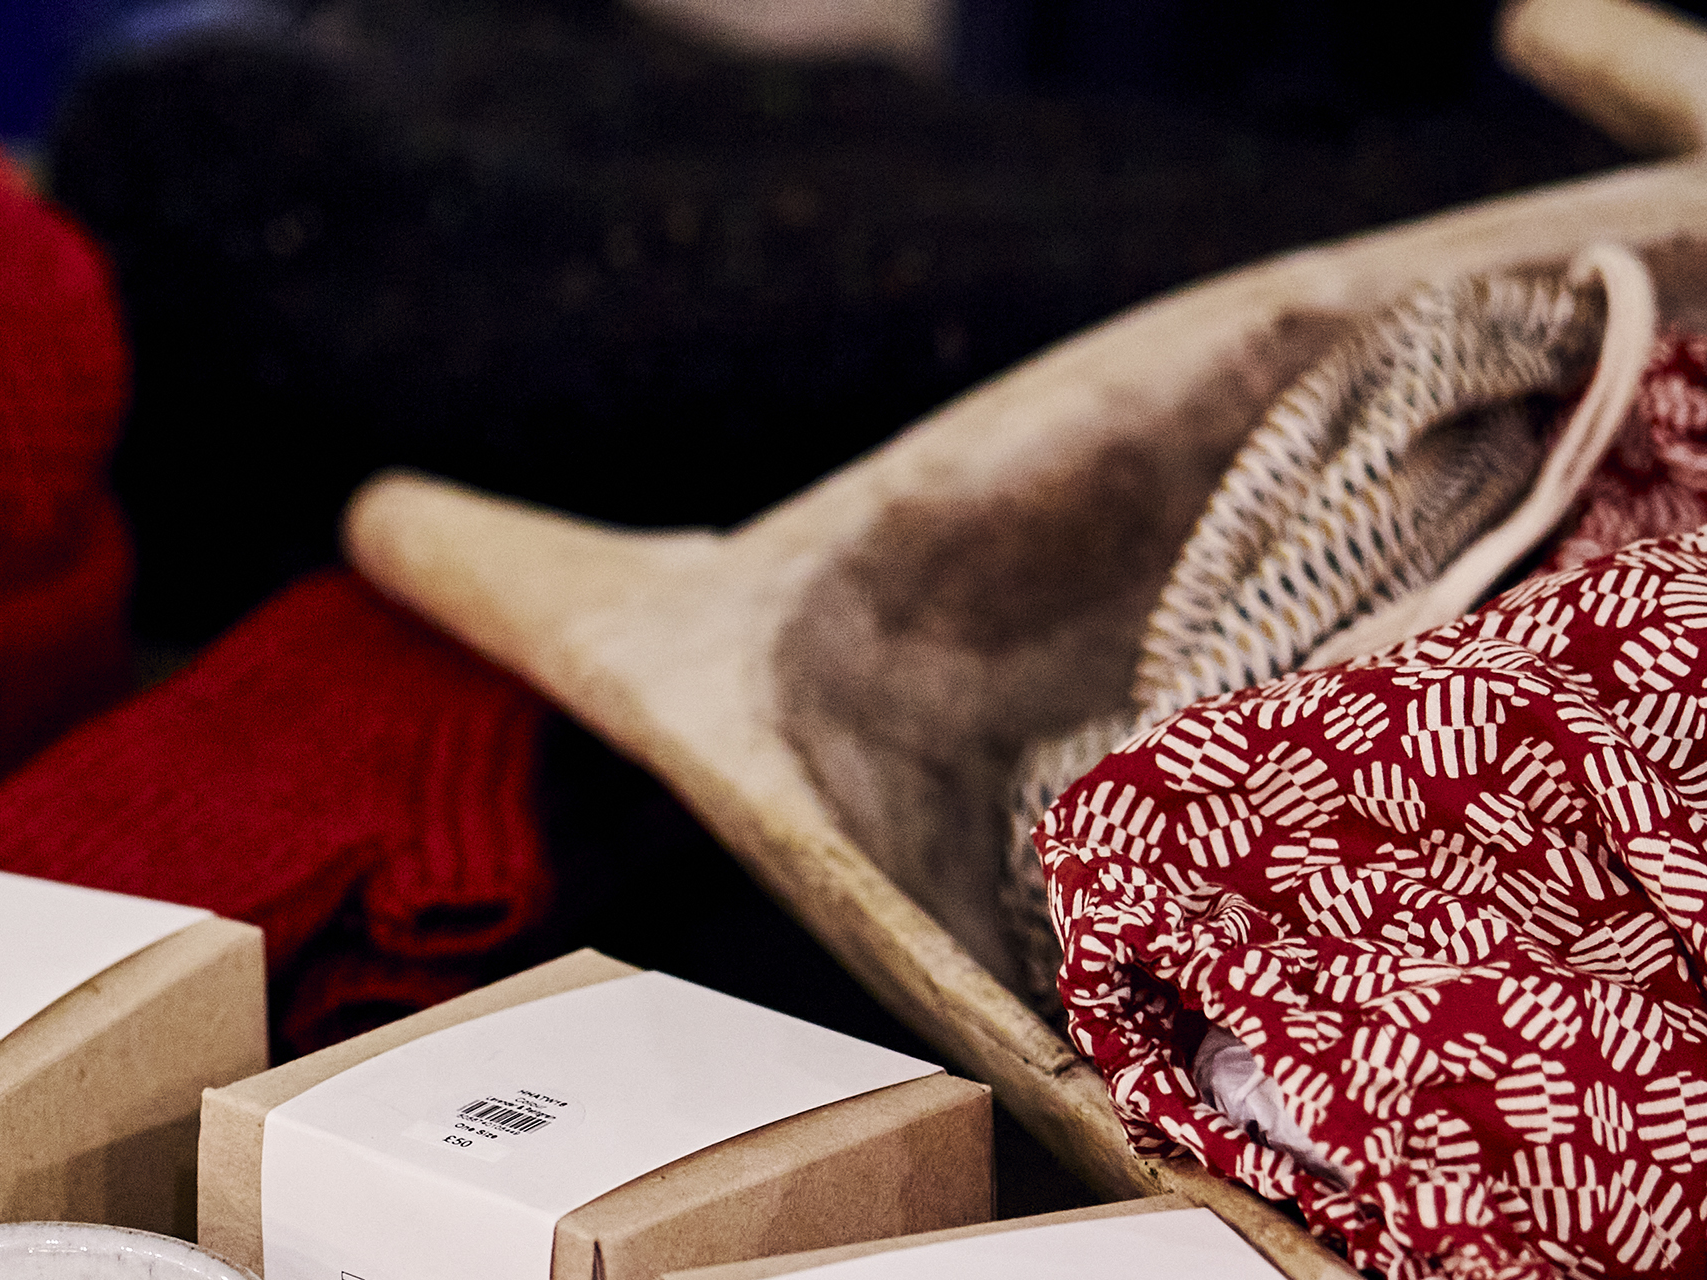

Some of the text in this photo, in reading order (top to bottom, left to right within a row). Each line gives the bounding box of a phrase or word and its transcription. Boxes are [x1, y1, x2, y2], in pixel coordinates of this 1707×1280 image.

[454, 1122, 498, 1139] One Size
[442, 1135, 473, 1147] £50
